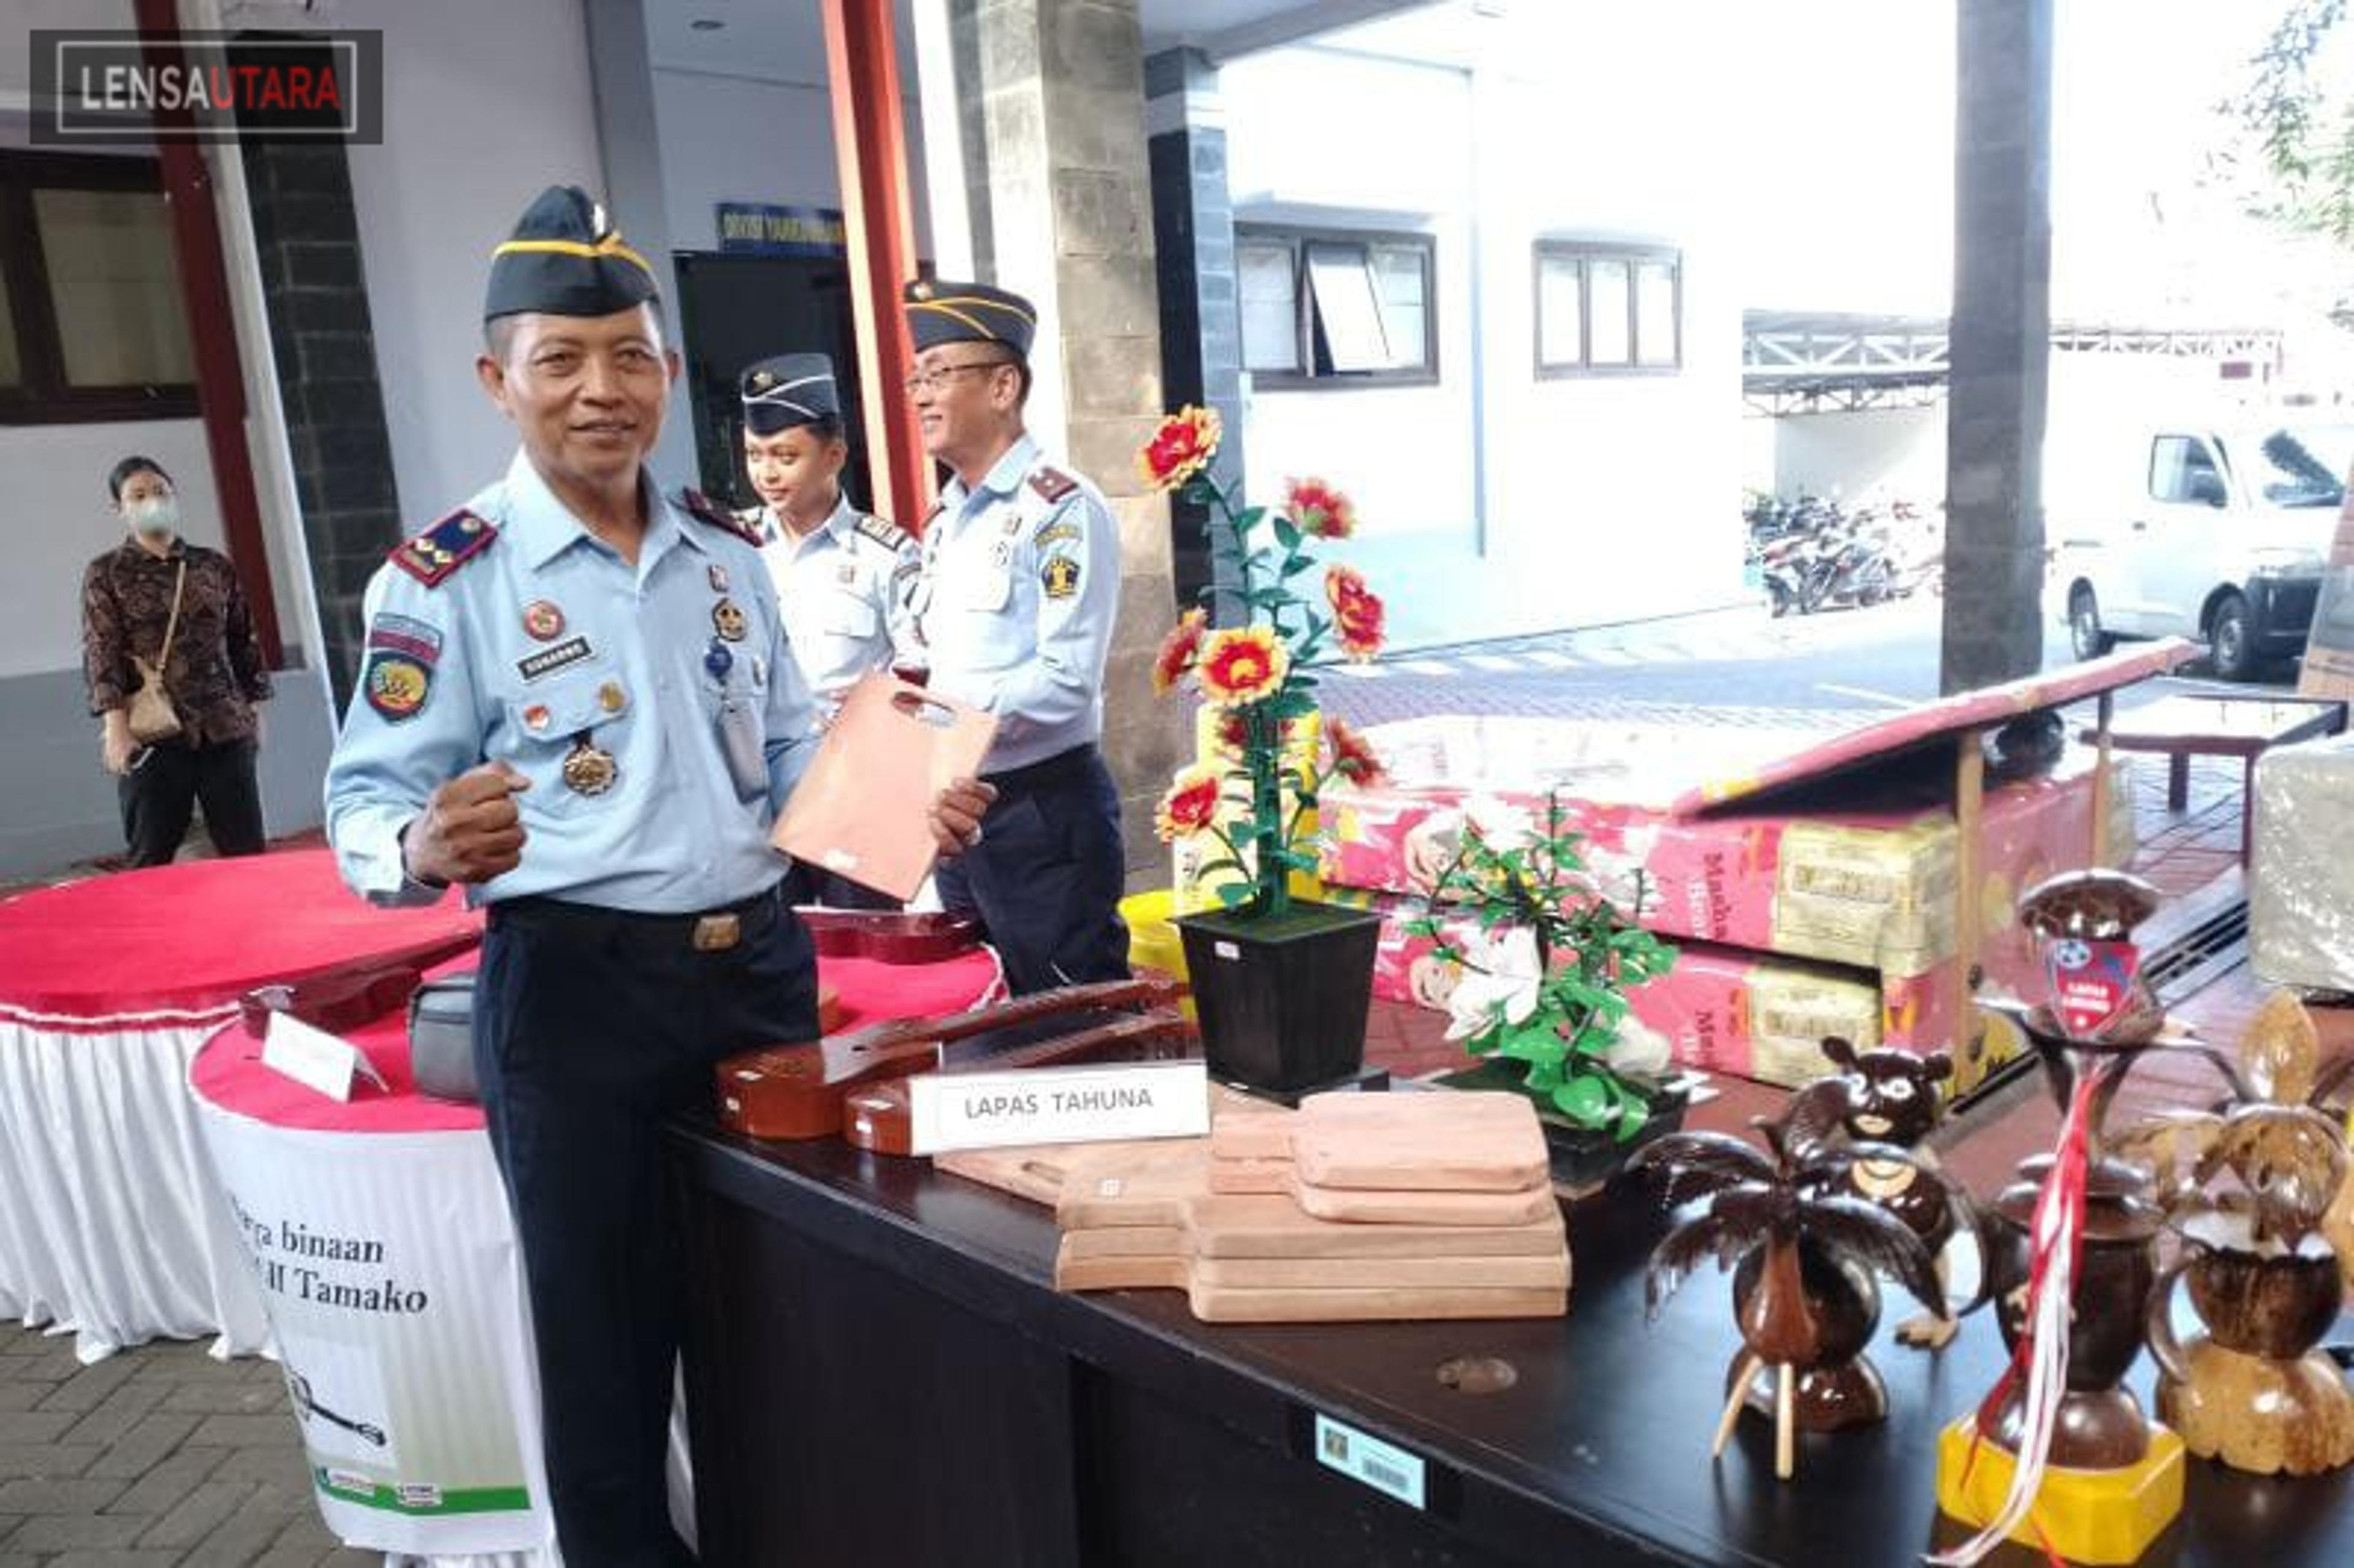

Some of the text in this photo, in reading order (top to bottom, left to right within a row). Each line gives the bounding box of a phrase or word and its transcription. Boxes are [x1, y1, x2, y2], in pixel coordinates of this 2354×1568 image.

[964, 1087, 1154, 1119] LAPAS TAHUNA
[281, 1220, 384, 1263] binaan
[293, 1266, 429, 1314] Tamako
